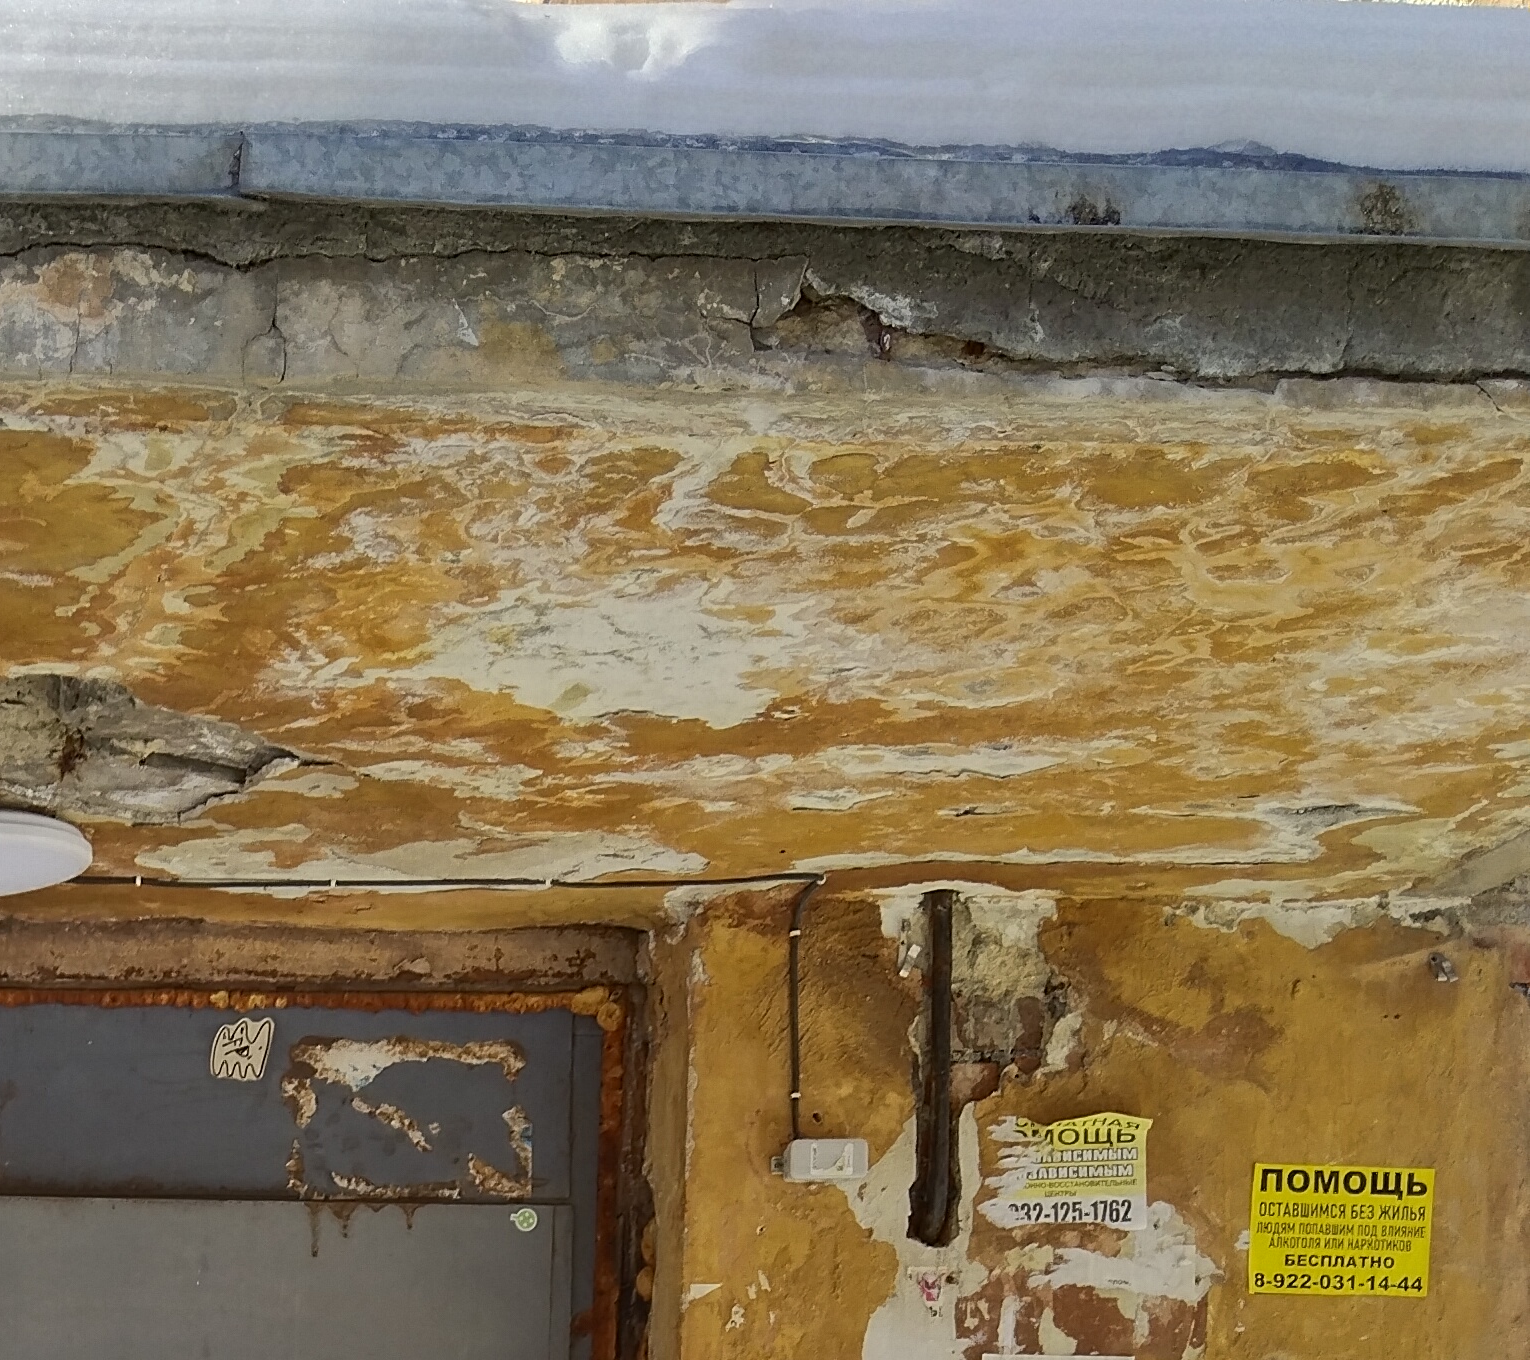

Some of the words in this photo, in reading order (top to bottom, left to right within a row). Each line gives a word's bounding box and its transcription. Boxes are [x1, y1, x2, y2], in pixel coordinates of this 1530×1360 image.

[1260, 1168, 1428, 1201] ПОМОЩЬ
[1258, 1201, 1346, 1219] ОСТАВШИМСЯ
[1350, 1204, 1375, 1219] БЕЗ
[1378, 1204, 1426, 1222] ЖИЛЬЯ
[1256, 1222, 1295, 1235] ЛЮДЯМ
[1298, 1222, 1354, 1237] ПОПАВШИМ
[1357, 1224, 1377, 1237] ПОД
[1381, 1225, 1426, 1239] ВЛИЯНИЕ
[1268, 1236, 1321, 1249] АЛКОГОЛЯ
[1324, 1237, 1344, 1250] ИЛИ
[1347, 1238, 1412, 1252] НАРКОТИКОВ
[1284, 1254, 1395, 1269] БЕСПЛАТНО
[1254, 1273, 1423, 1292] 8-922-031-14-44
